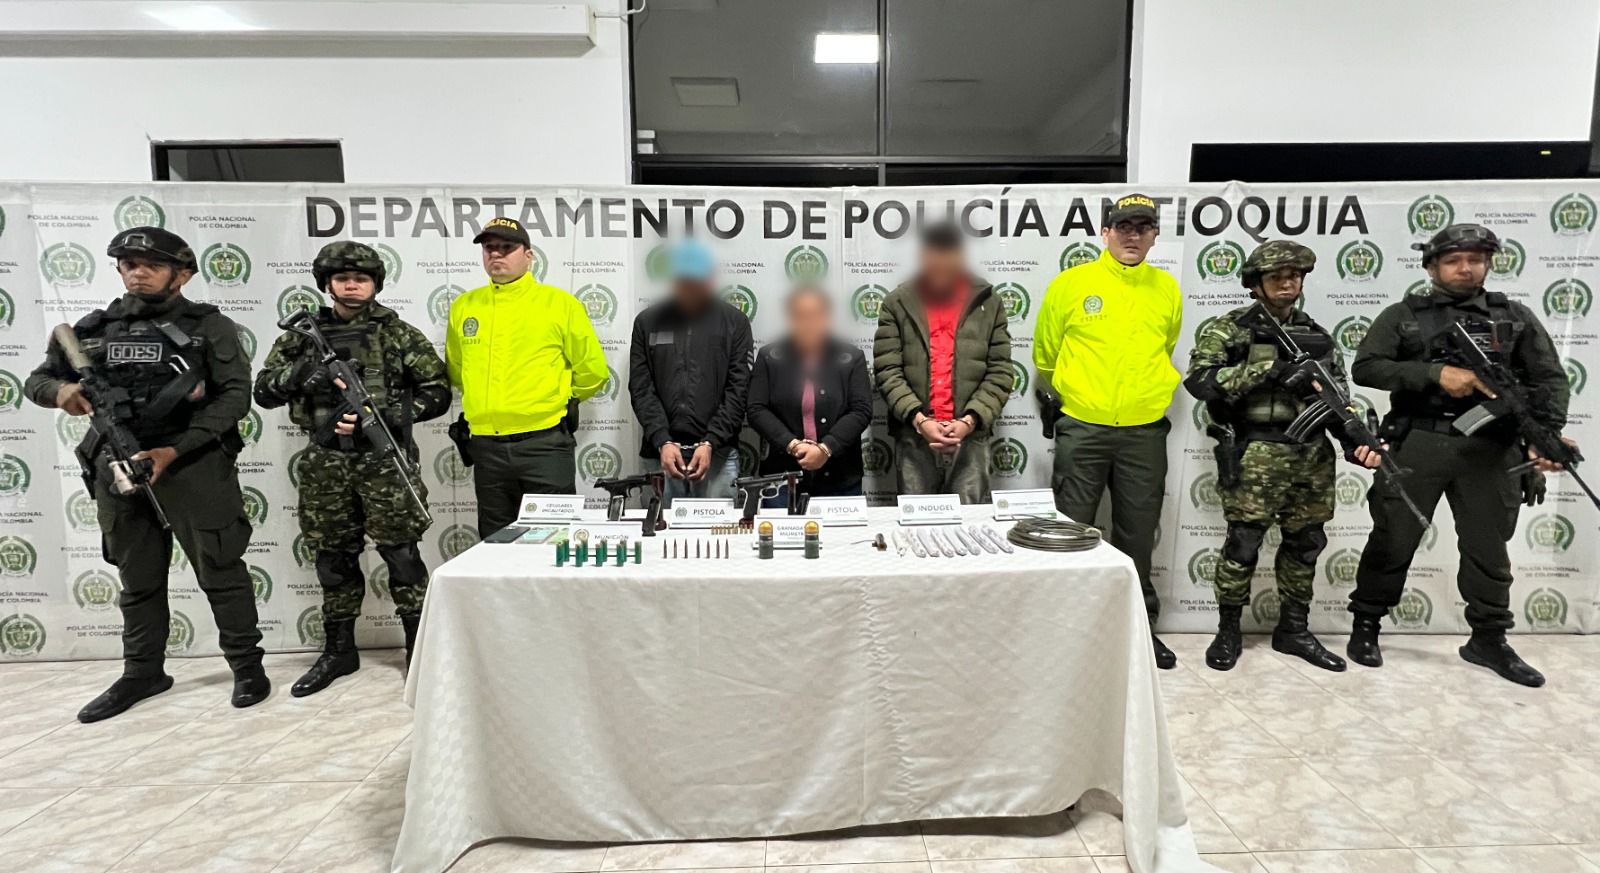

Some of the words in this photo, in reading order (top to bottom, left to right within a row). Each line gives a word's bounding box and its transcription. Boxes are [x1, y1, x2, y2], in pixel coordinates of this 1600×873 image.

[1117, 197, 1155, 209] POLICIA
[28, 213, 59, 221] POLICÍA
[306, 196, 745, 240] DEPARTAMENTO
[763, 200, 827, 240] DE
[1060, 195, 1369, 244] ATIOQUIA
[111, 345, 158, 360] GOES
[693, 508, 726, 516] PISTOLA
[919, 504, 954, 512] INDUGEL
[97, 624, 124, 632] NACION
